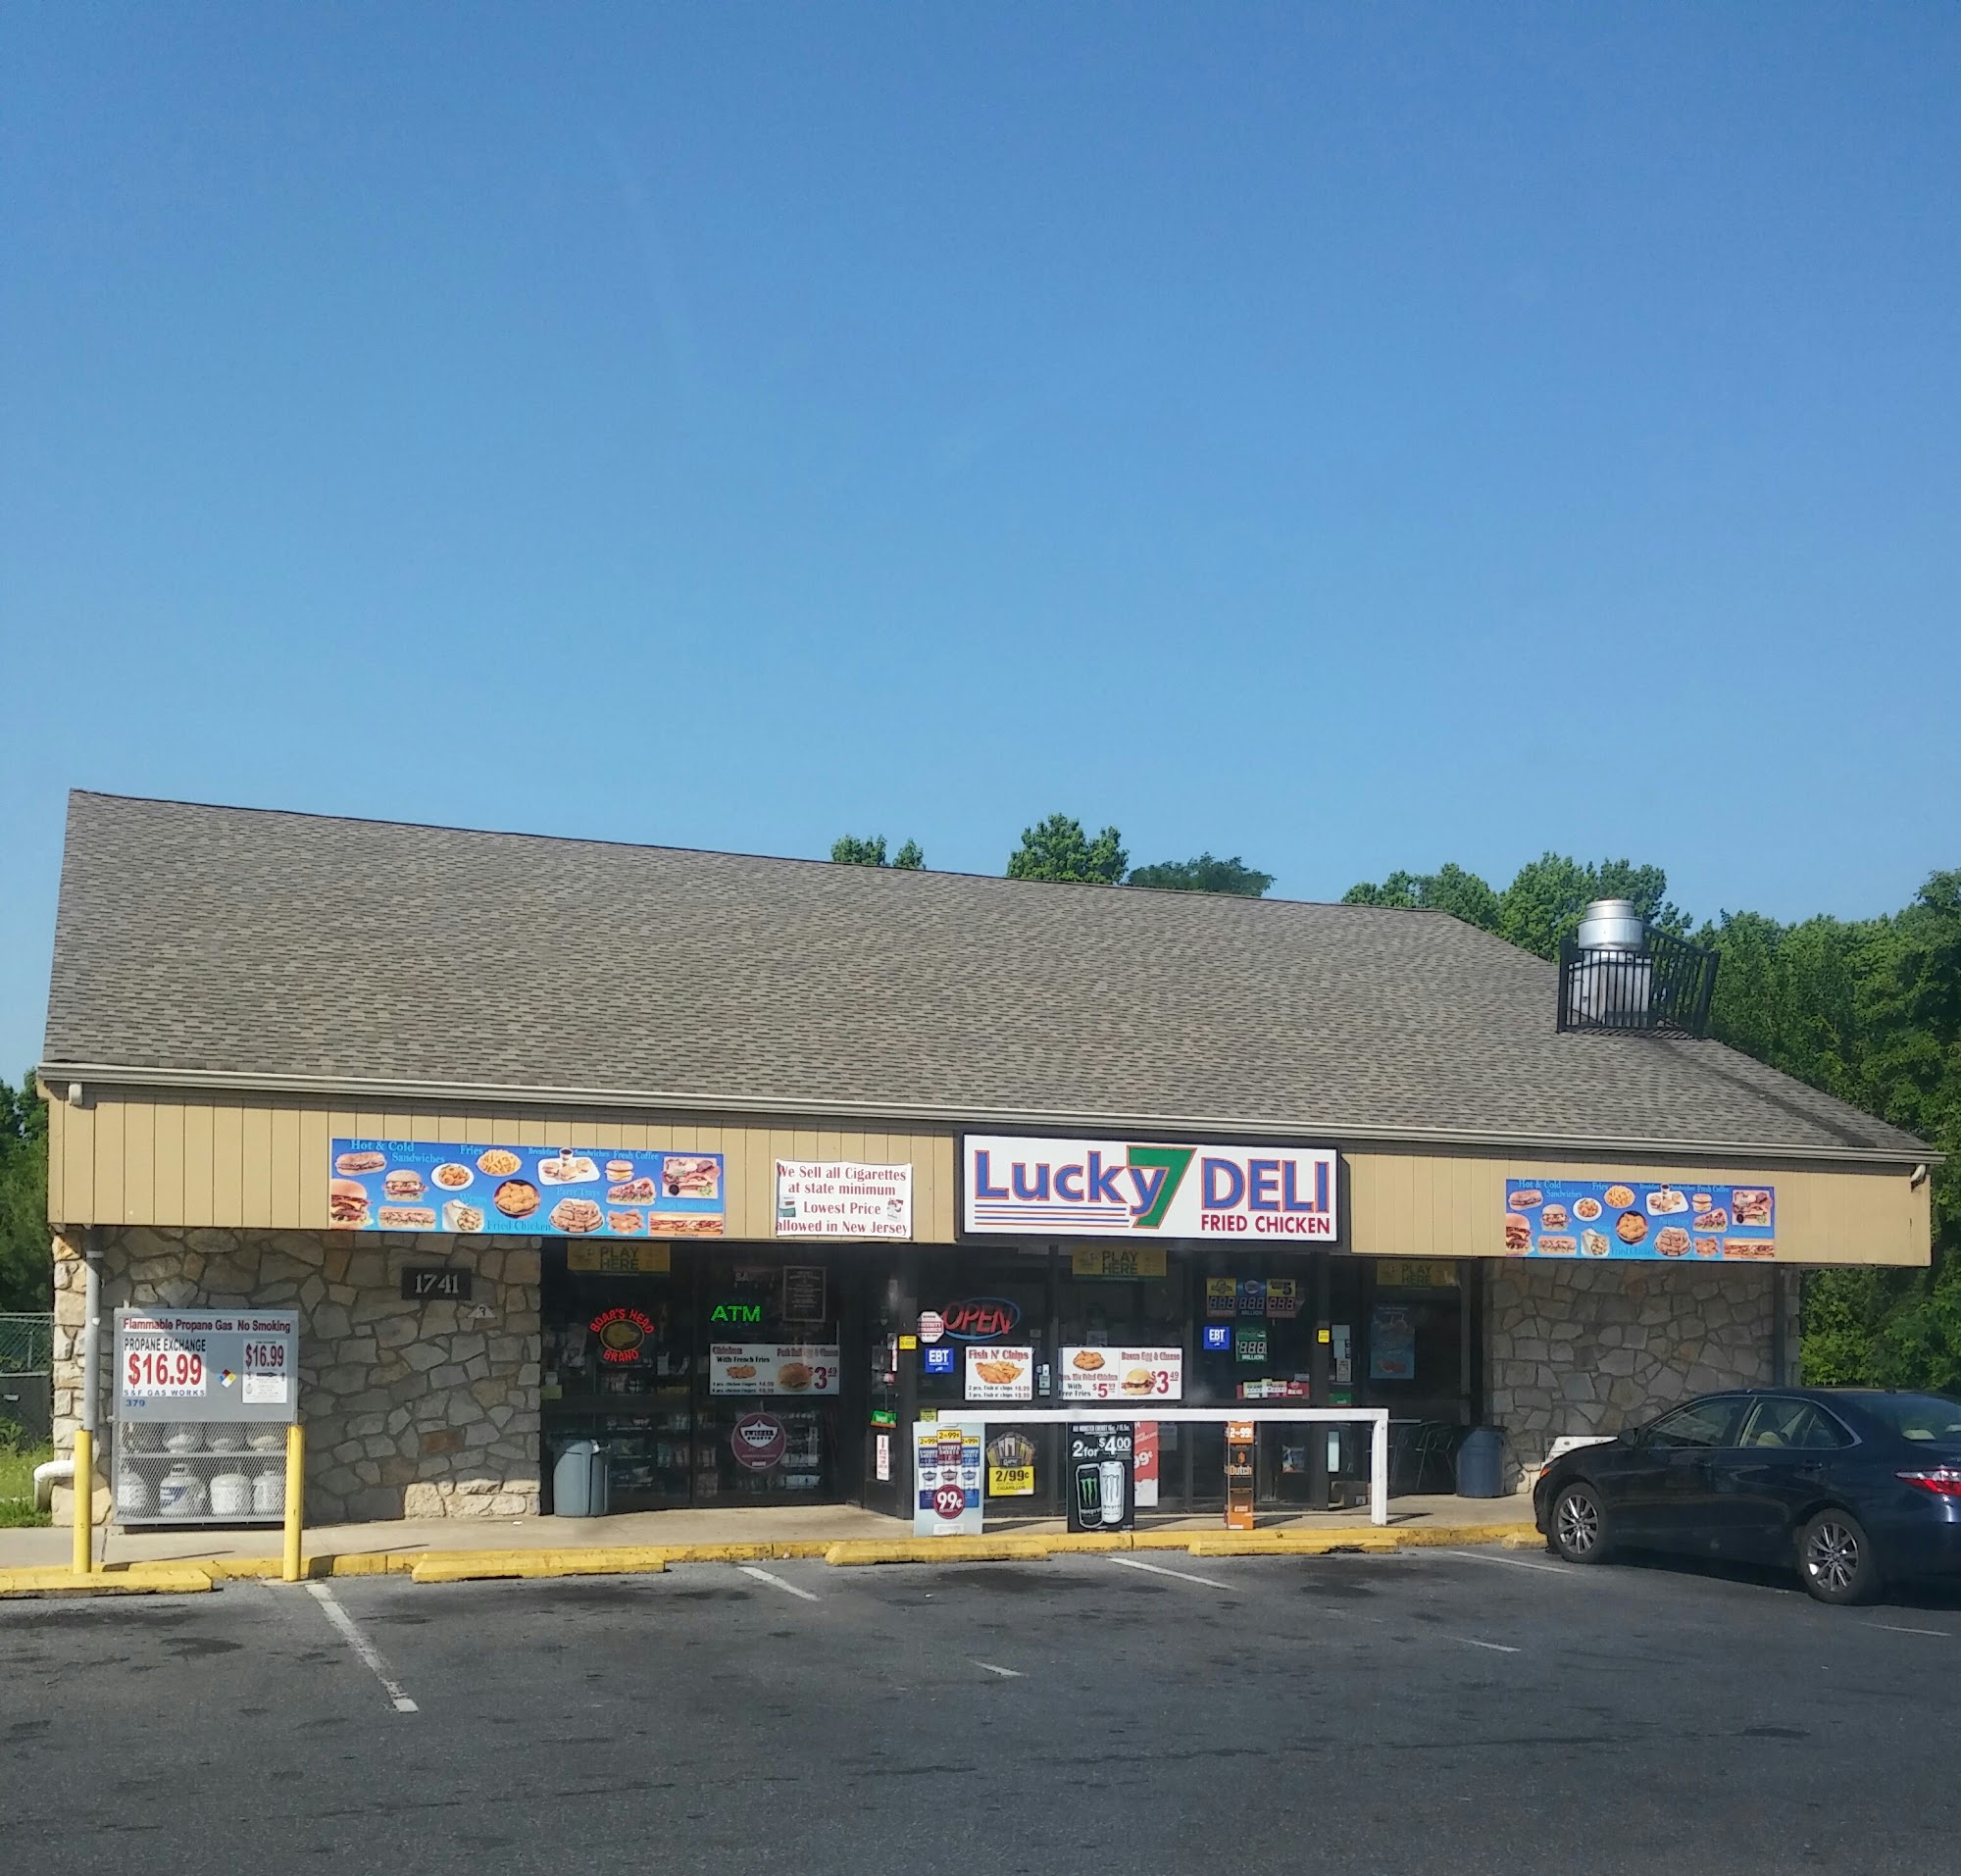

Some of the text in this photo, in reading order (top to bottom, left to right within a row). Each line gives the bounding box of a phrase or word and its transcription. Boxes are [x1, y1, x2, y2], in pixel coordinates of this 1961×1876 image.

[350, 1141, 415, 1152] Hot & Cold
[460, 1145, 482, 1155] Fries
[391, 1152, 445, 1163] Sandwiches
[613, 1150, 659, 1160] Fresh Coffee
[778, 1164, 907, 1183] We Sell all Cigarettes
[788, 1183, 896, 1195] at state minimum
[974, 1145, 1197, 1229] Lucky 7
[1200, 1156, 1330, 1214] DELI
[1543, 1181, 1562, 1190] Cold
[1546, 1190, 1583, 1198] Sandwiches
[804, 1201, 881, 1214] Lowest Price
[486, 1220, 551, 1232] Fried Chicken
[776, 1220, 908, 1236] allowed in New Jersey
[1201, 1214, 1331, 1235] FRIED CHICKEN
[600, 1246, 639, 1258] PLAY
[1102, 1250, 1138, 1262] PLAY
[600, 1258, 639, 1270] HERE
[1103, 1263, 1138, 1274] HERE
[1401, 1264, 1432, 1274] PLAY
[415, 1274, 459, 1293] 1741
[711, 1305, 761, 1322] ATM
[943, 1302, 1013, 1335] OPEN
[123, 1318, 291, 1333] Flammable Propane Gas No Smoking
[589, 1308, 655, 1334] BOAR'S HEAD
[1209, 1329, 1225, 1341] EBT
[125, 1338, 206, 1351] PROPANE EXCHANGE
[245, 1344, 284, 1369] $16.99
[603, 1348, 640, 1362] BRAND
[929, 1349, 949, 1363] EBT
[968, 1349, 1029, 1361] Fish N' Chips
[1141, 1352, 1153, 1362] Egg
[1159, 1352, 1181, 1361] Cheese
[128, 1352, 202, 1389] $16.99
[1072, 1440, 1083, 1456] 2
[1083, 1446, 1099, 1457] for
[995, 1470, 1030, 1482] 2/99¢
[1230, 1464, 1252, 1476] Dutch
[936, 1491, 963, 1510] 99¢
